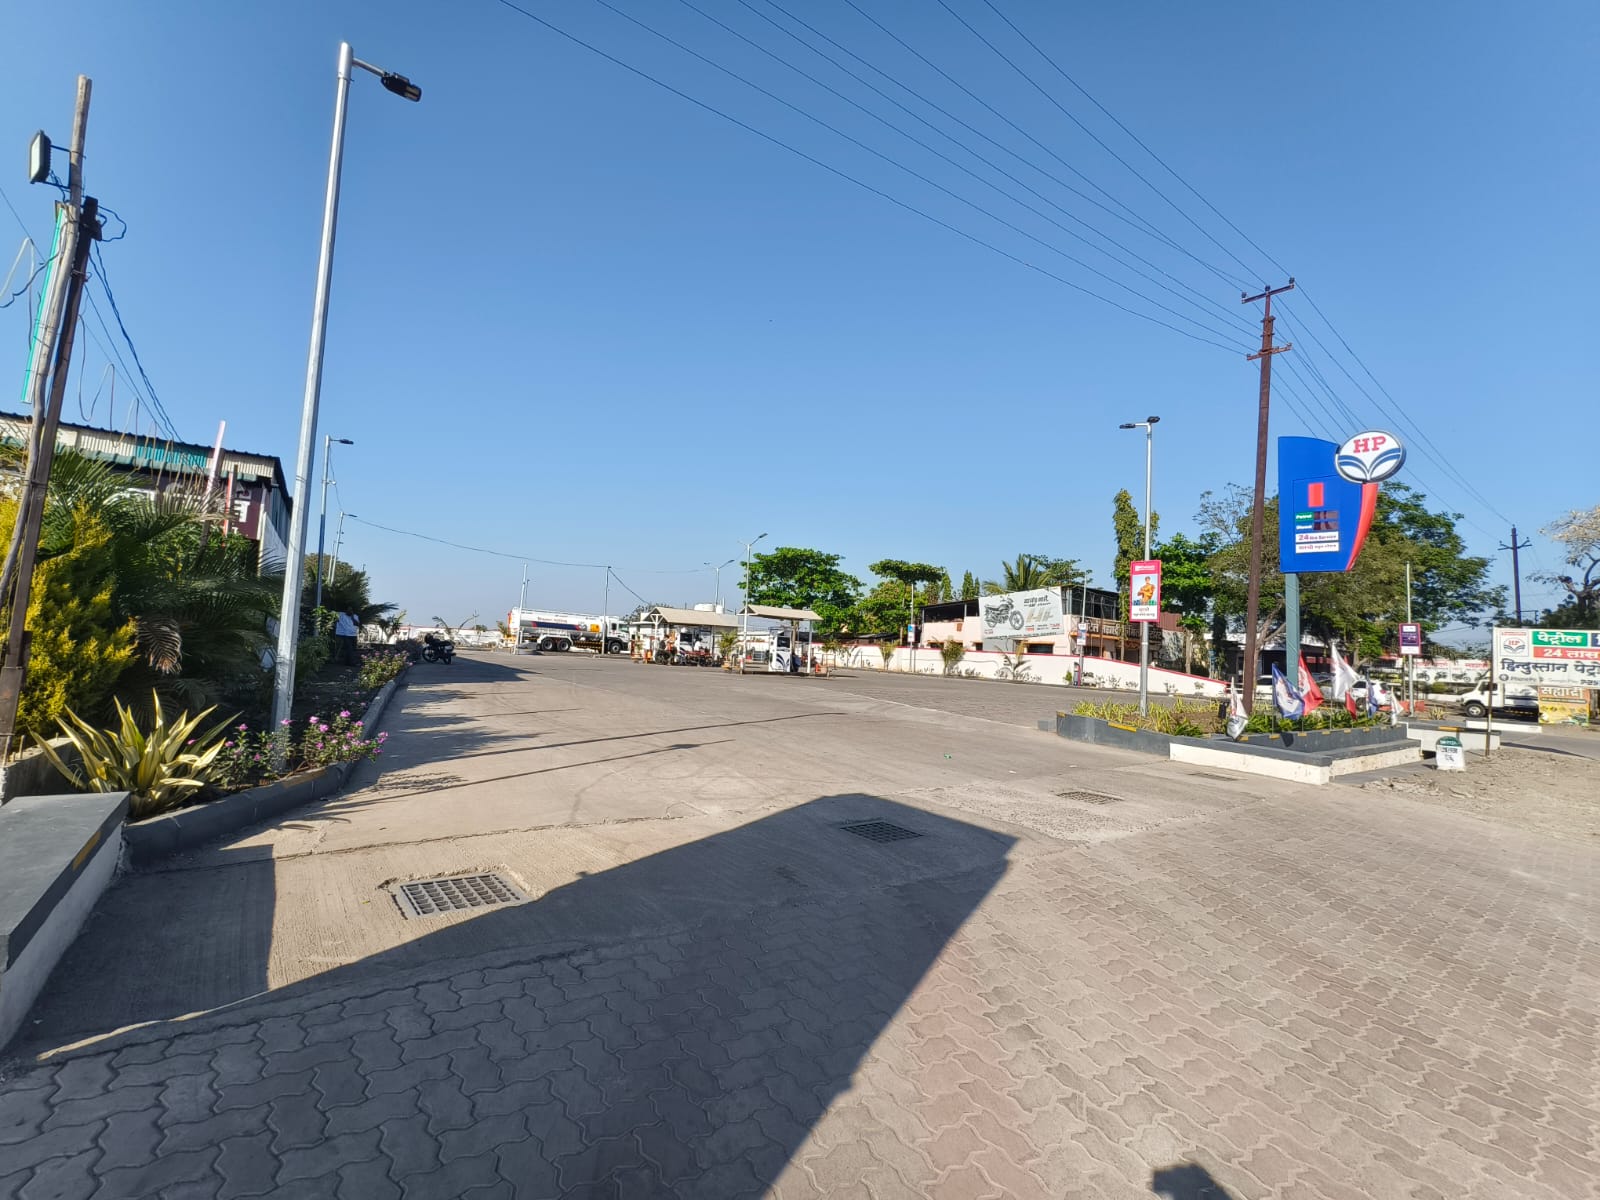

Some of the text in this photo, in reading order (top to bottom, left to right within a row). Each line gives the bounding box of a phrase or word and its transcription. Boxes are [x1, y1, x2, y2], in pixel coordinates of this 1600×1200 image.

[1353, 436, 1386, 453] HP
[1538, 632, 1582, 645] पेट्रोल
[1543, 648, 1563, 657] 24
